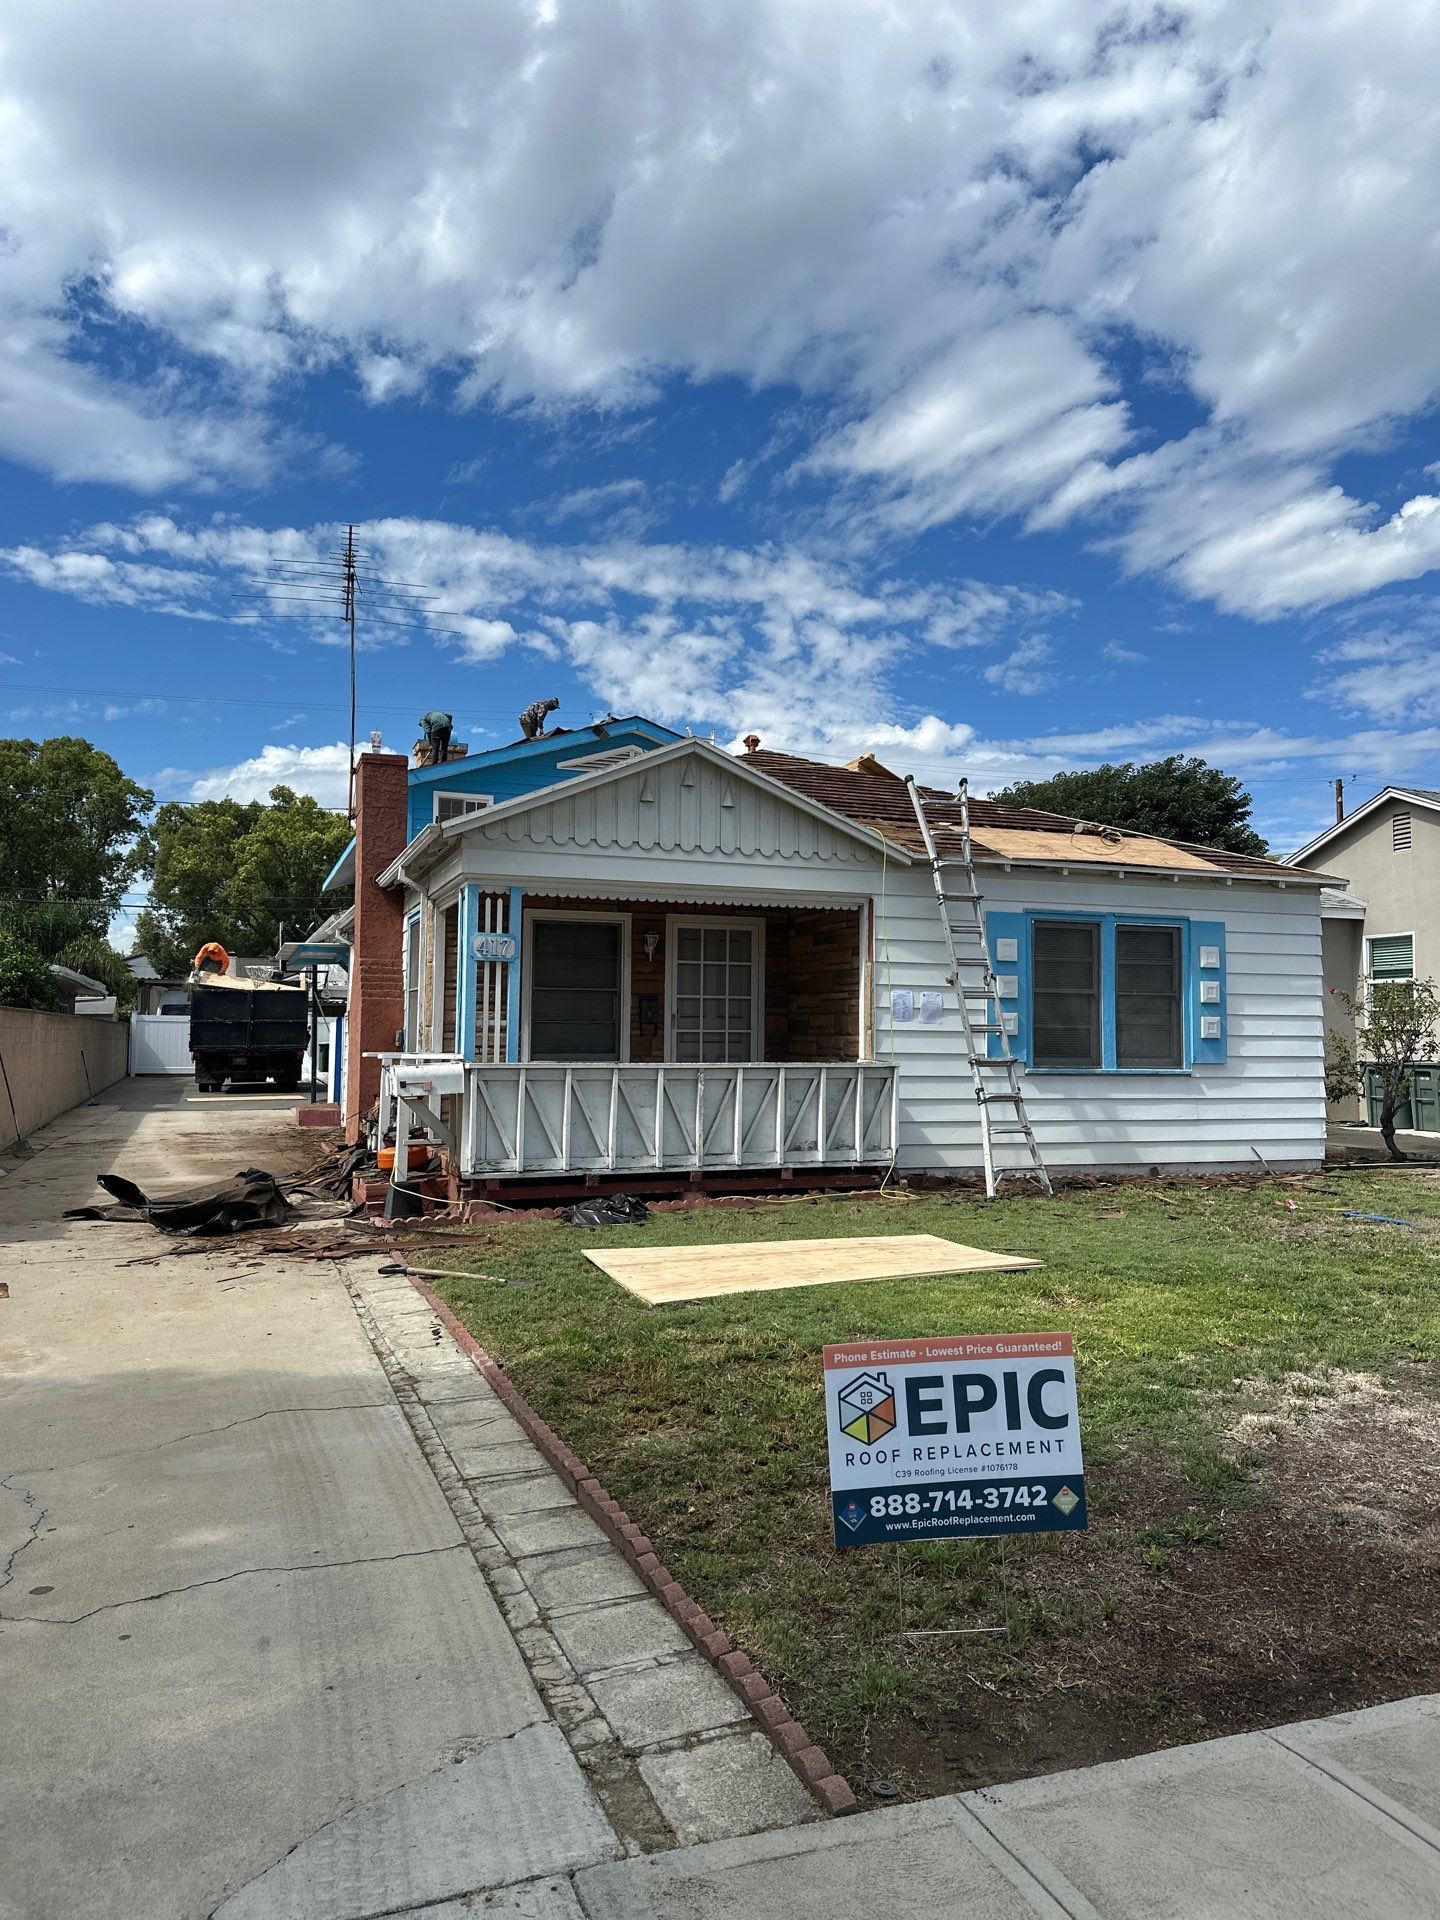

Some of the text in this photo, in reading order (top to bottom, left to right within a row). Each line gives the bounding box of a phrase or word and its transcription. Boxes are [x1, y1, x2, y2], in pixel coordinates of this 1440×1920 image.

[477, 936, 512, 956] 417
[834, 1353, 867, 1363] Phone
[870, 1349, 916, 1360] Estimate
[926, 1346, 963, 1357] Lowest
[966, 1343, 992, 1354] Price
[996, 1341, 1062, 1352] Guaranteed!
[904, 1368, 1069, 1437] EPIC
[846, 1439, 1065, 1466] ROOF REPLACEMENT
[895, 1462, 1018, 1478] C39 Roofing License #1076178
[869, 1485, 1048, 1517] 888-714-3742
[885, 1512, 1036, 1531] www.EpicRoofReplacement.com
